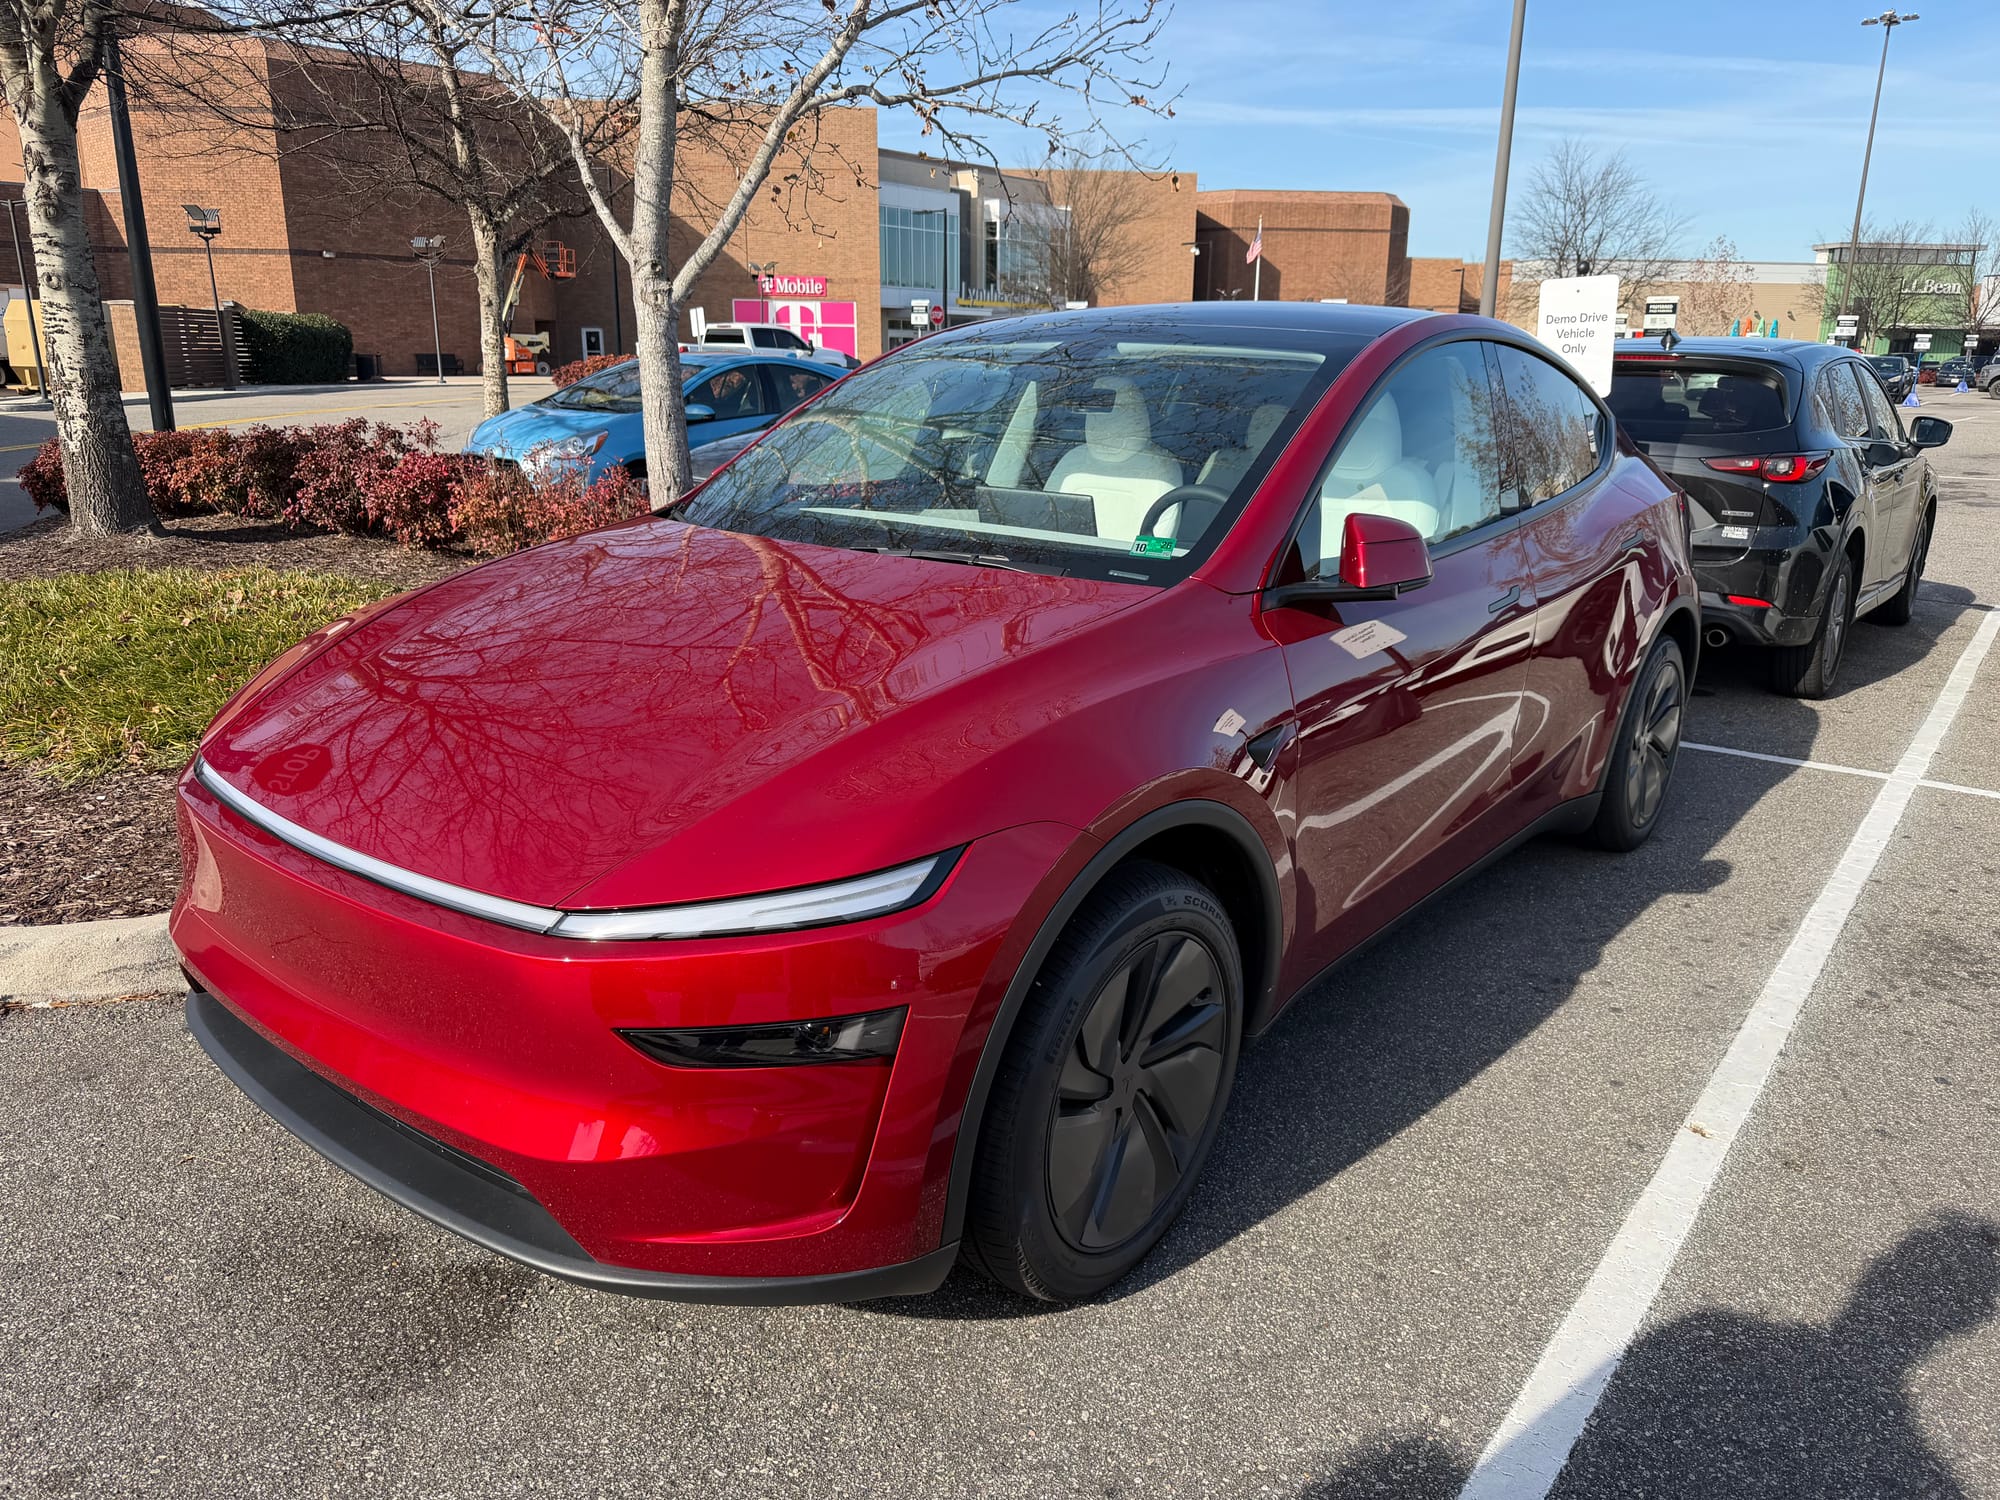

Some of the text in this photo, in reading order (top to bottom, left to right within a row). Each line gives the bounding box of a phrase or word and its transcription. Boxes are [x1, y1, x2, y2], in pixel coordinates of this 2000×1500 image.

[775, 277, 824, 295] Mobile
[1546, 314, 1577, 325] Demo
[1579, 312, 1608, 323] Drive
[1556, 328, 1595, 339] Vehicle
[1561, 343, 1587, 356] Only
[1135, 543, 1147, 553] 10
[1161, 541, 1172, 550] 26
